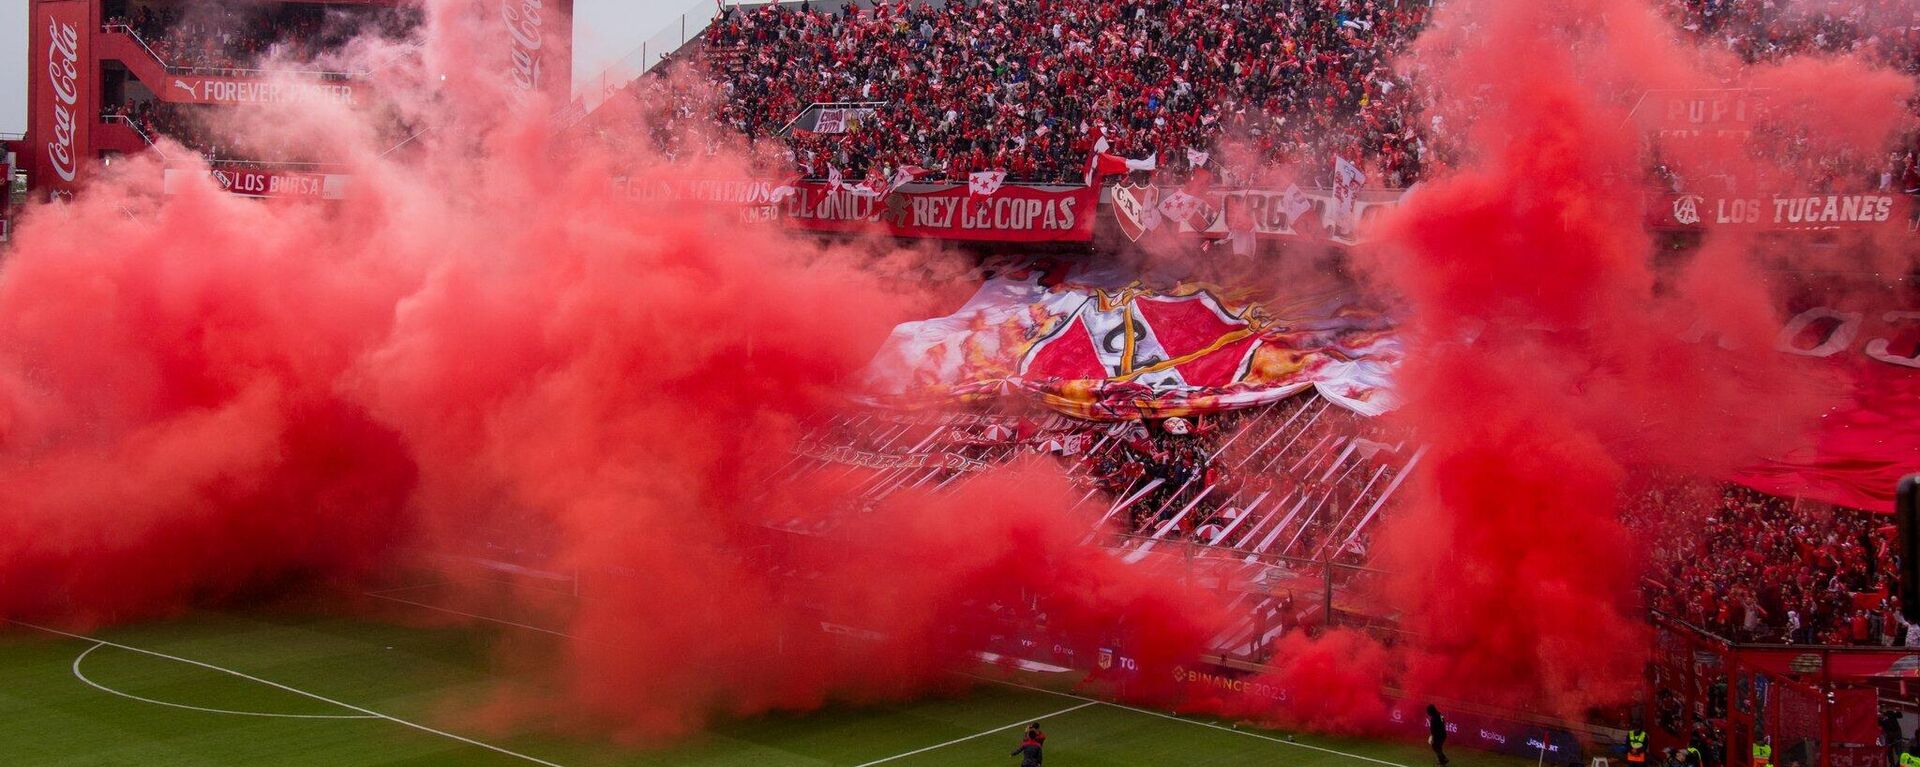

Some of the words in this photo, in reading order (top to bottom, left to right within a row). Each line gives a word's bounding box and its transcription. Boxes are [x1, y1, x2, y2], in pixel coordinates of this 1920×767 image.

[48, 15, 78, 182] Coca-Cola
[234, 172, 264, 192] LOS
[269, 175, 319, 195] BURSA
[788, 186, 814, 218] EL
[913, 196, 960, 229] REY
[994, 196, 1076, 230] COPAS
[1716, 199, 1761, 224] LOS
[1773, 195, 1893, 224] TUCANES
[1188, 671, 1251, 693] BINANCE
[1254, 682, 1287, 701] 2023
